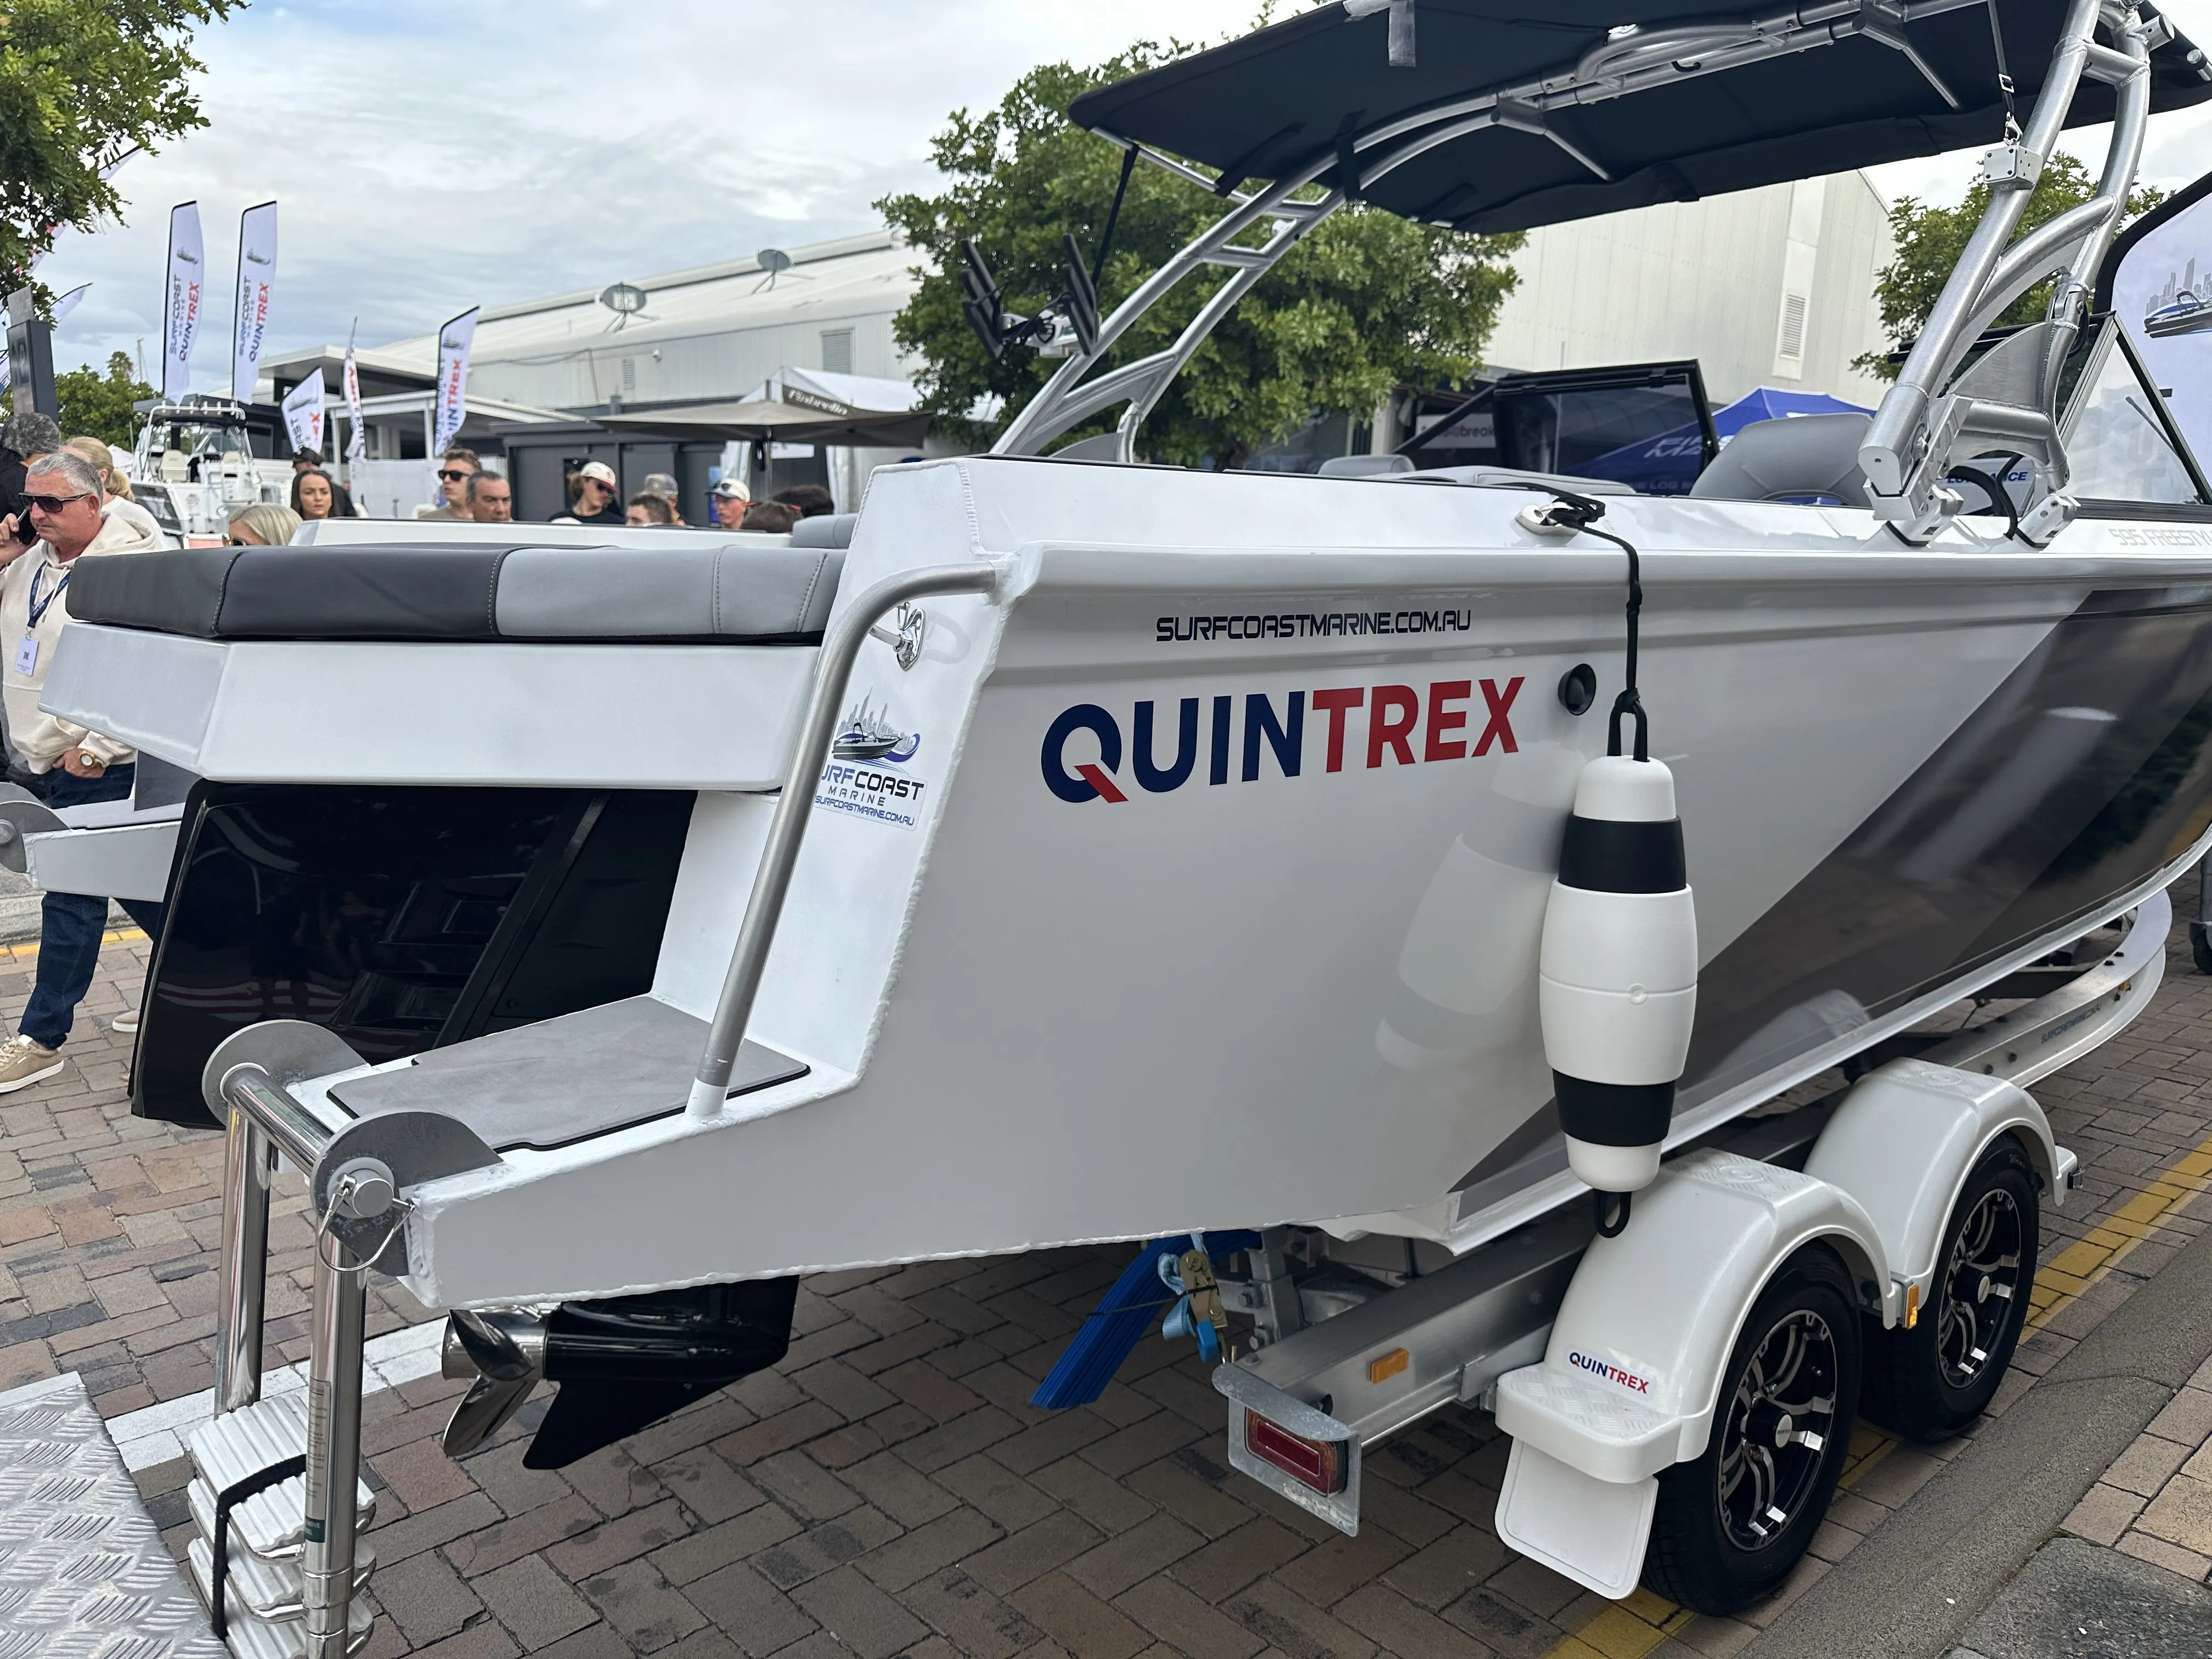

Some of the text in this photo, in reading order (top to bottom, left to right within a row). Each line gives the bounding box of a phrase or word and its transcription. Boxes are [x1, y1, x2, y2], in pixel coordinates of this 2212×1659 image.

[179, 282, 200, 362] QUINTREX
[249, 283, 269, 363] QUINTREX
[447, 358, 462, 432] INTREX
[2108, 528, 2212, 546] 595 FREESTYL
[1156, 610, 1471, 641] SURFCOASTMARINE.COM.AU
[1041, 676, 1525, 803] QUINTREX
[821, 765, 924, 800] URFCOAST
[828, 785, 886, 806] MARINE
[815, 795, 915, 826] SURFCOASTMARINE.COM.AU
[1569, 1352, 1649, 1394] QUINTREX
